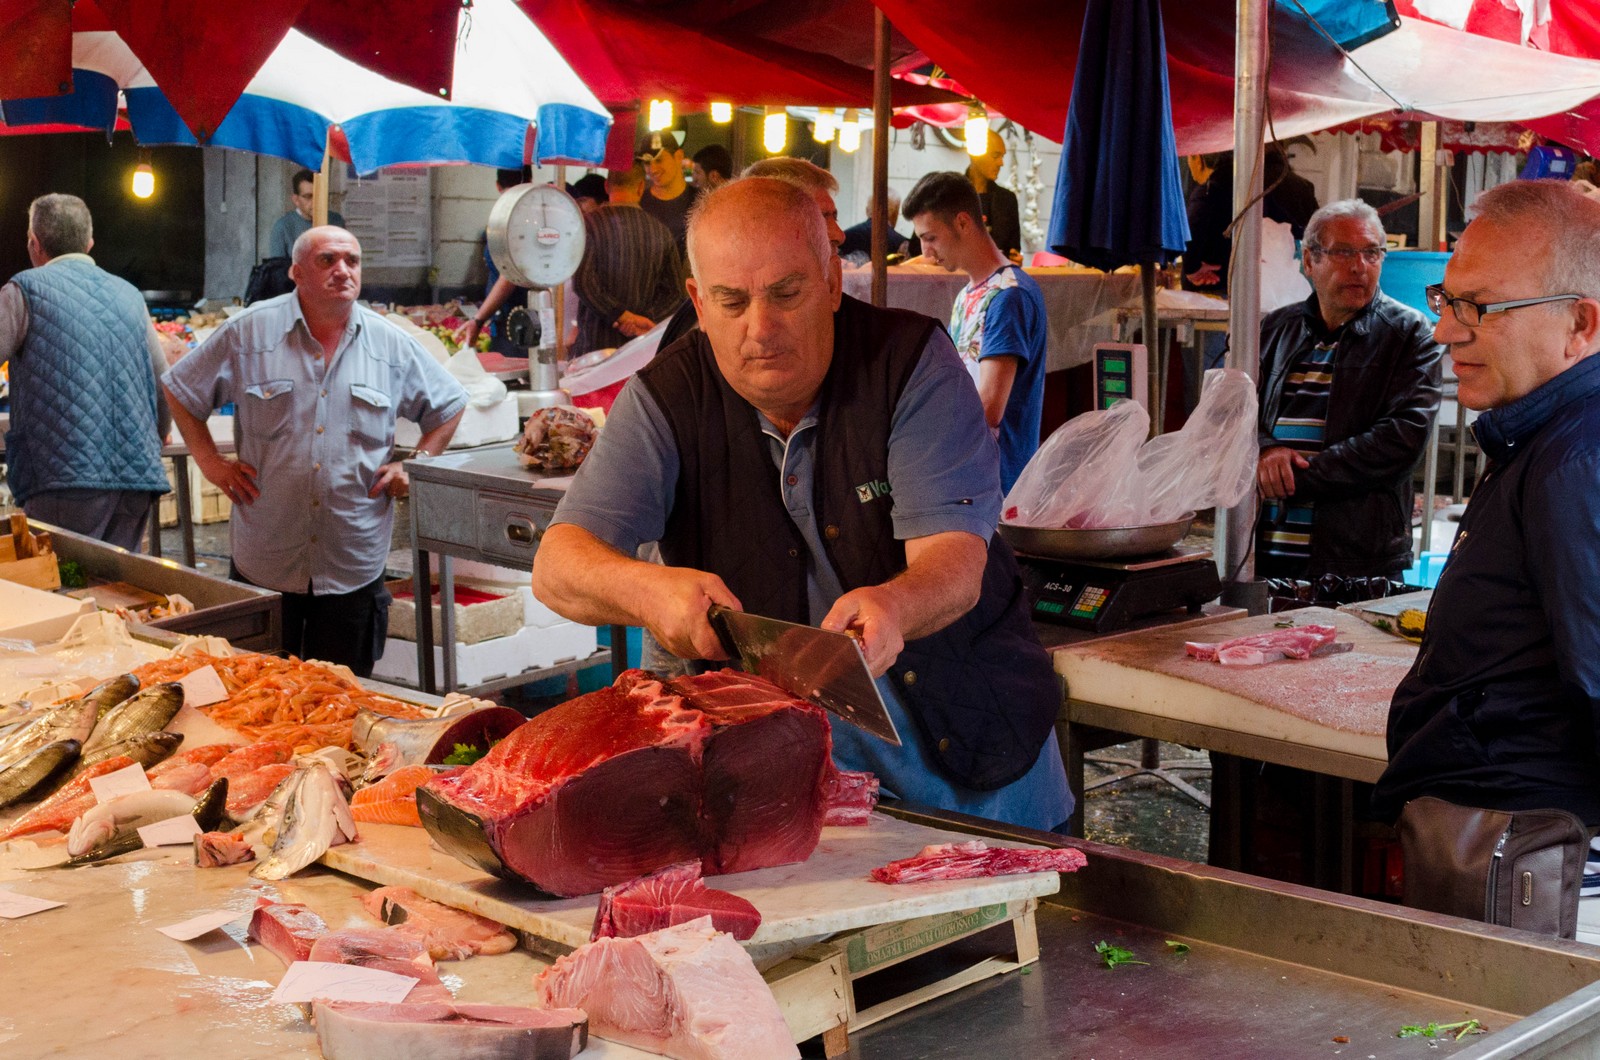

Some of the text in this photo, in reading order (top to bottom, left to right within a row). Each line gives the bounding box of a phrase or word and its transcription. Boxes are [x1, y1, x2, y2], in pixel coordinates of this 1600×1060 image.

[1044, 582, 1073, 593] ACS-30
[934, 914, 979, 938] CONSORZIO
[903, 931, 934, 951] FUNGHI
[867, 941, 901, 963] TREVISO
